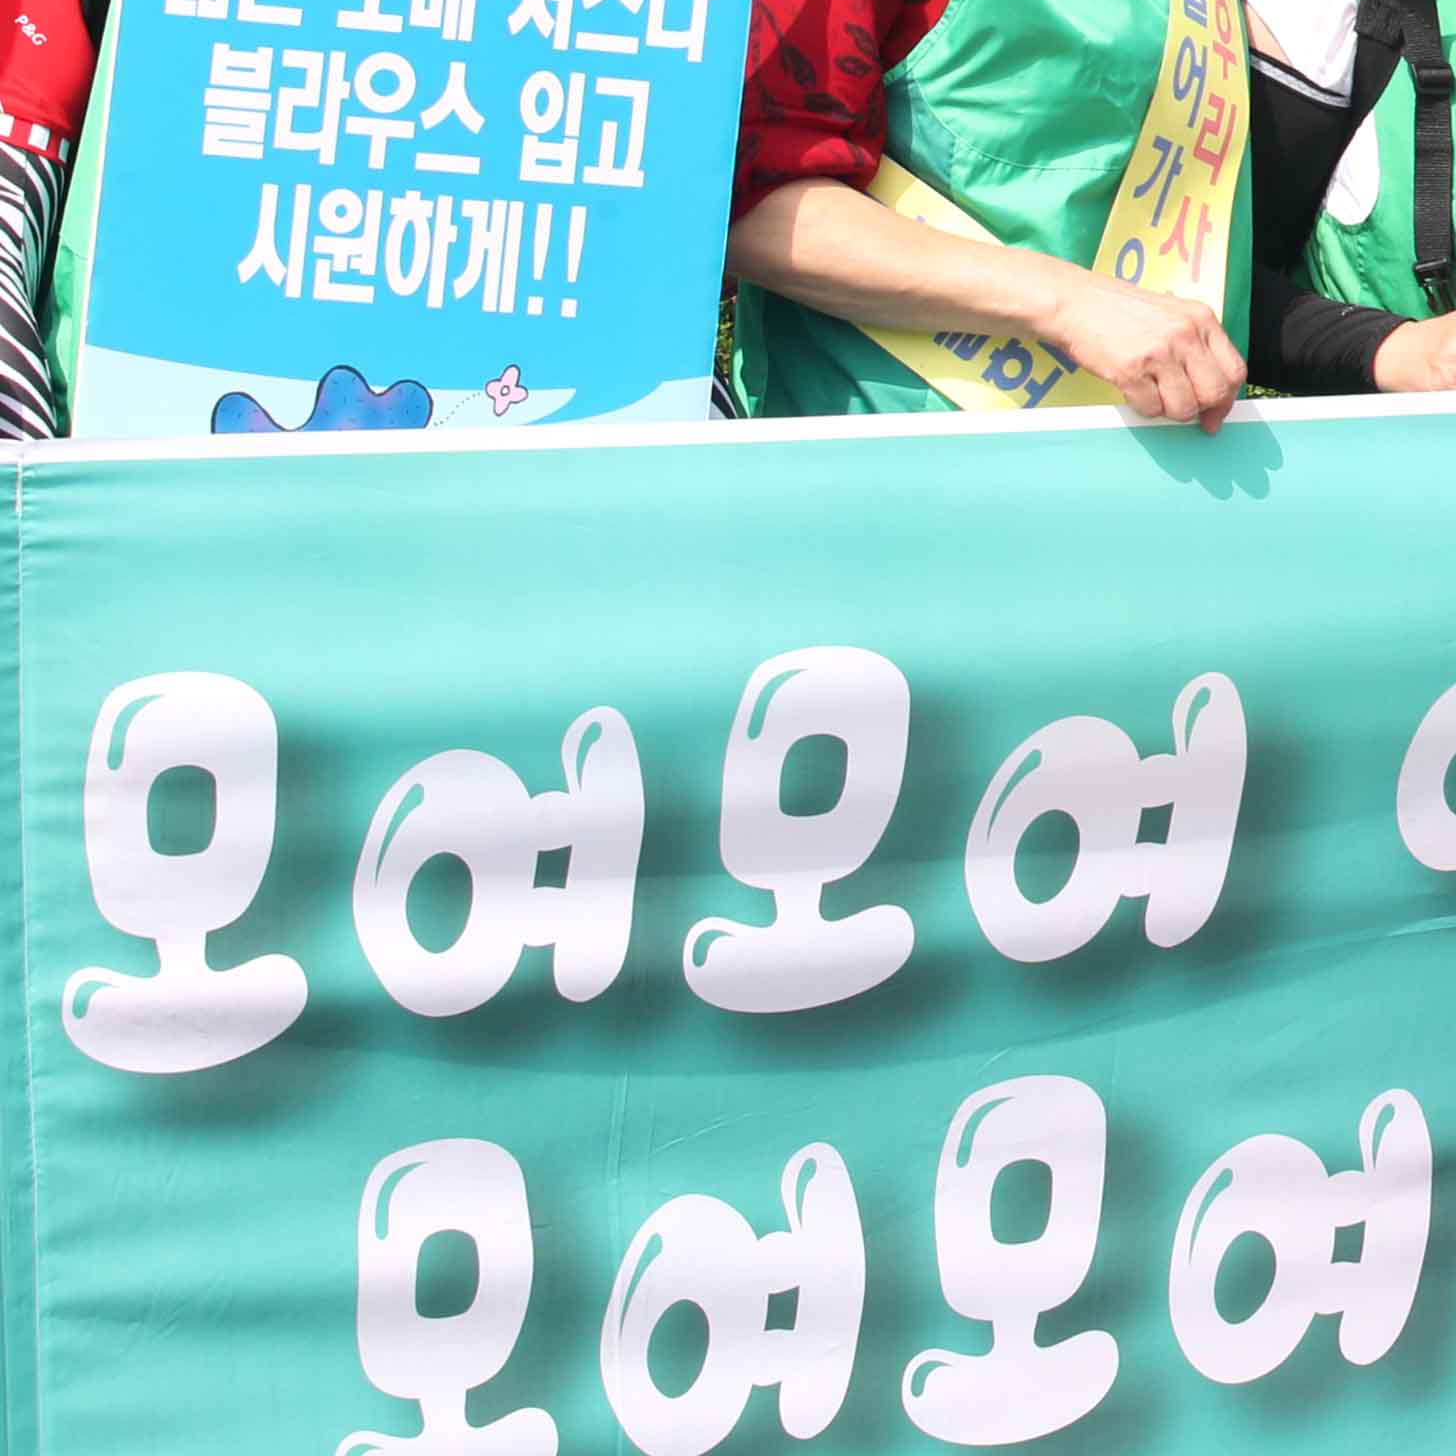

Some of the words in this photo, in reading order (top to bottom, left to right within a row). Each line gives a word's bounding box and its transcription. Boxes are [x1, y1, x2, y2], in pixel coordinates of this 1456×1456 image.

[201, 43, 486, 175] 블라우스
[519, 69, 650, 188] 입고
[237, 183, 587, 318] 시원하게!!
